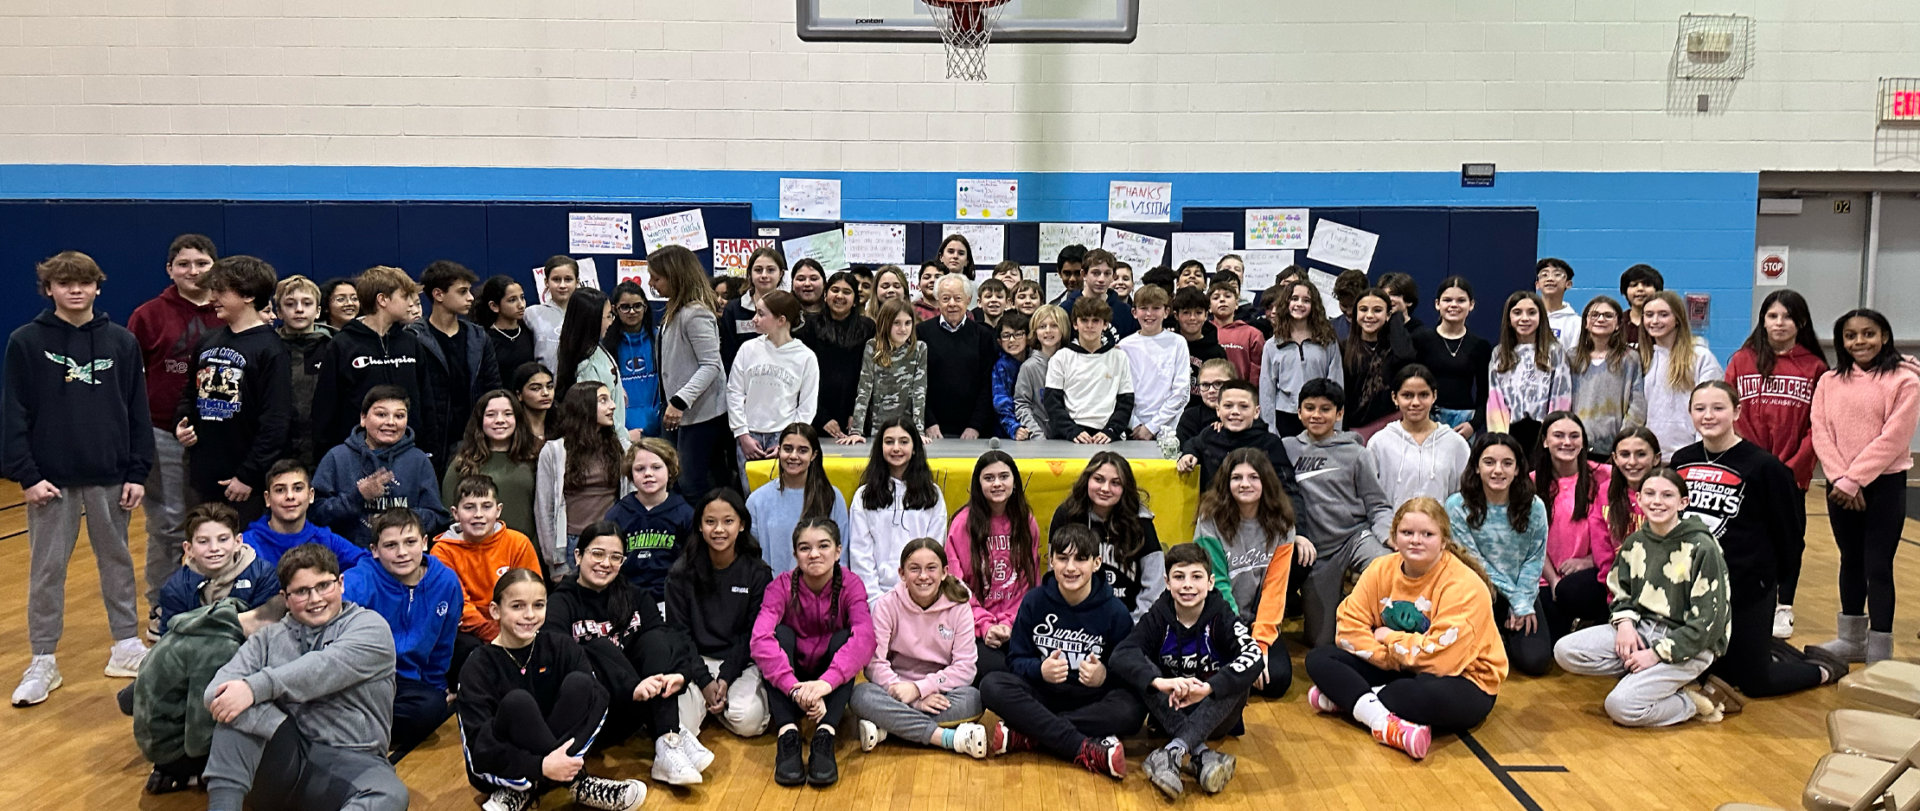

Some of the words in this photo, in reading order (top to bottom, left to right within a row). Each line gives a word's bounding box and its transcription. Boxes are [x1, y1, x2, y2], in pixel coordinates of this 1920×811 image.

[1114, 185, 1163, 200] THANKS
[1131, 200, 1171, 216] VISITING
[1834, 201, 1851, 213] D2
[642, 216, 678, 231] WELCOME
[679, 213, 693, 223] TO
[719, 253, 749, 268] YOU
[1763, 262, 1783, 272] STOP
[1294, 456, 1327, 471] NIKE
[1686, 467, 1723, 482] ESPN
[1693, 480, 1725, 495] WORLD
[1688, 489, 1740, 514] ORTS
[1033, 613, 1105, 651] Sundays
[1034, 636, 1049, 646] ARE
[1051, 639, 1064, 649] FOR
[1067, 642, 1081, 651] THE
